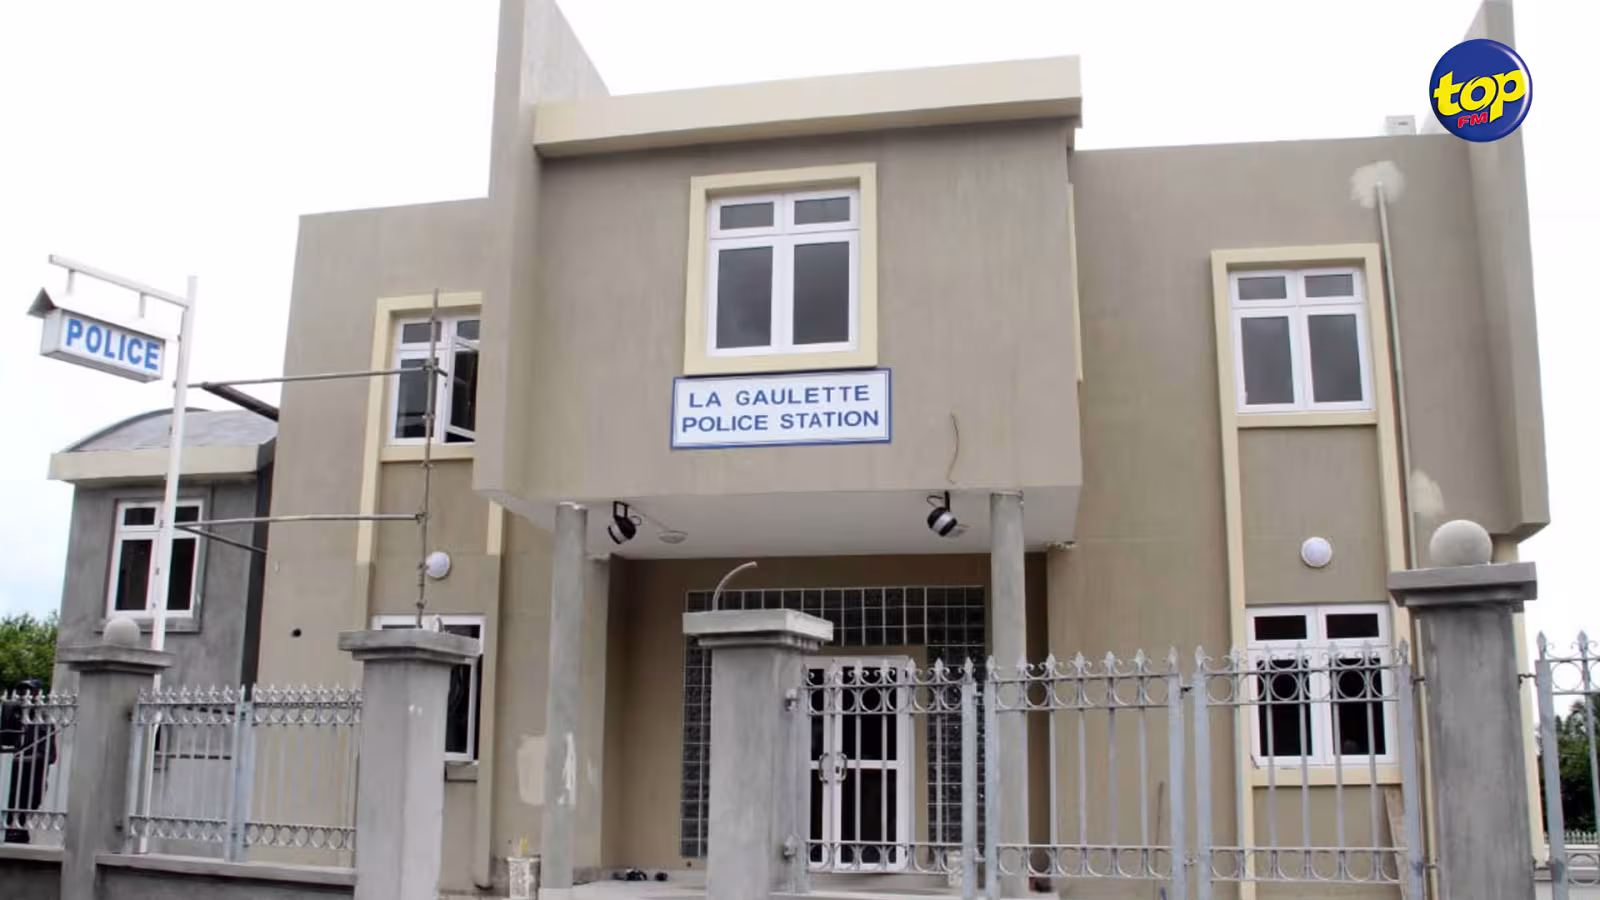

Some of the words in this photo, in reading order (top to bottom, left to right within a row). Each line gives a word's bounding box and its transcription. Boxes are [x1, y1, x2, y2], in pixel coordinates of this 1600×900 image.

[65, 318, 161, 370] POLICE
[689, 392, 721, 408] LA
[736, 385, 869, 406] GAULETTE
[682, 414, 768, 433] POLICE
[780, 410, 879, 429] STATION
